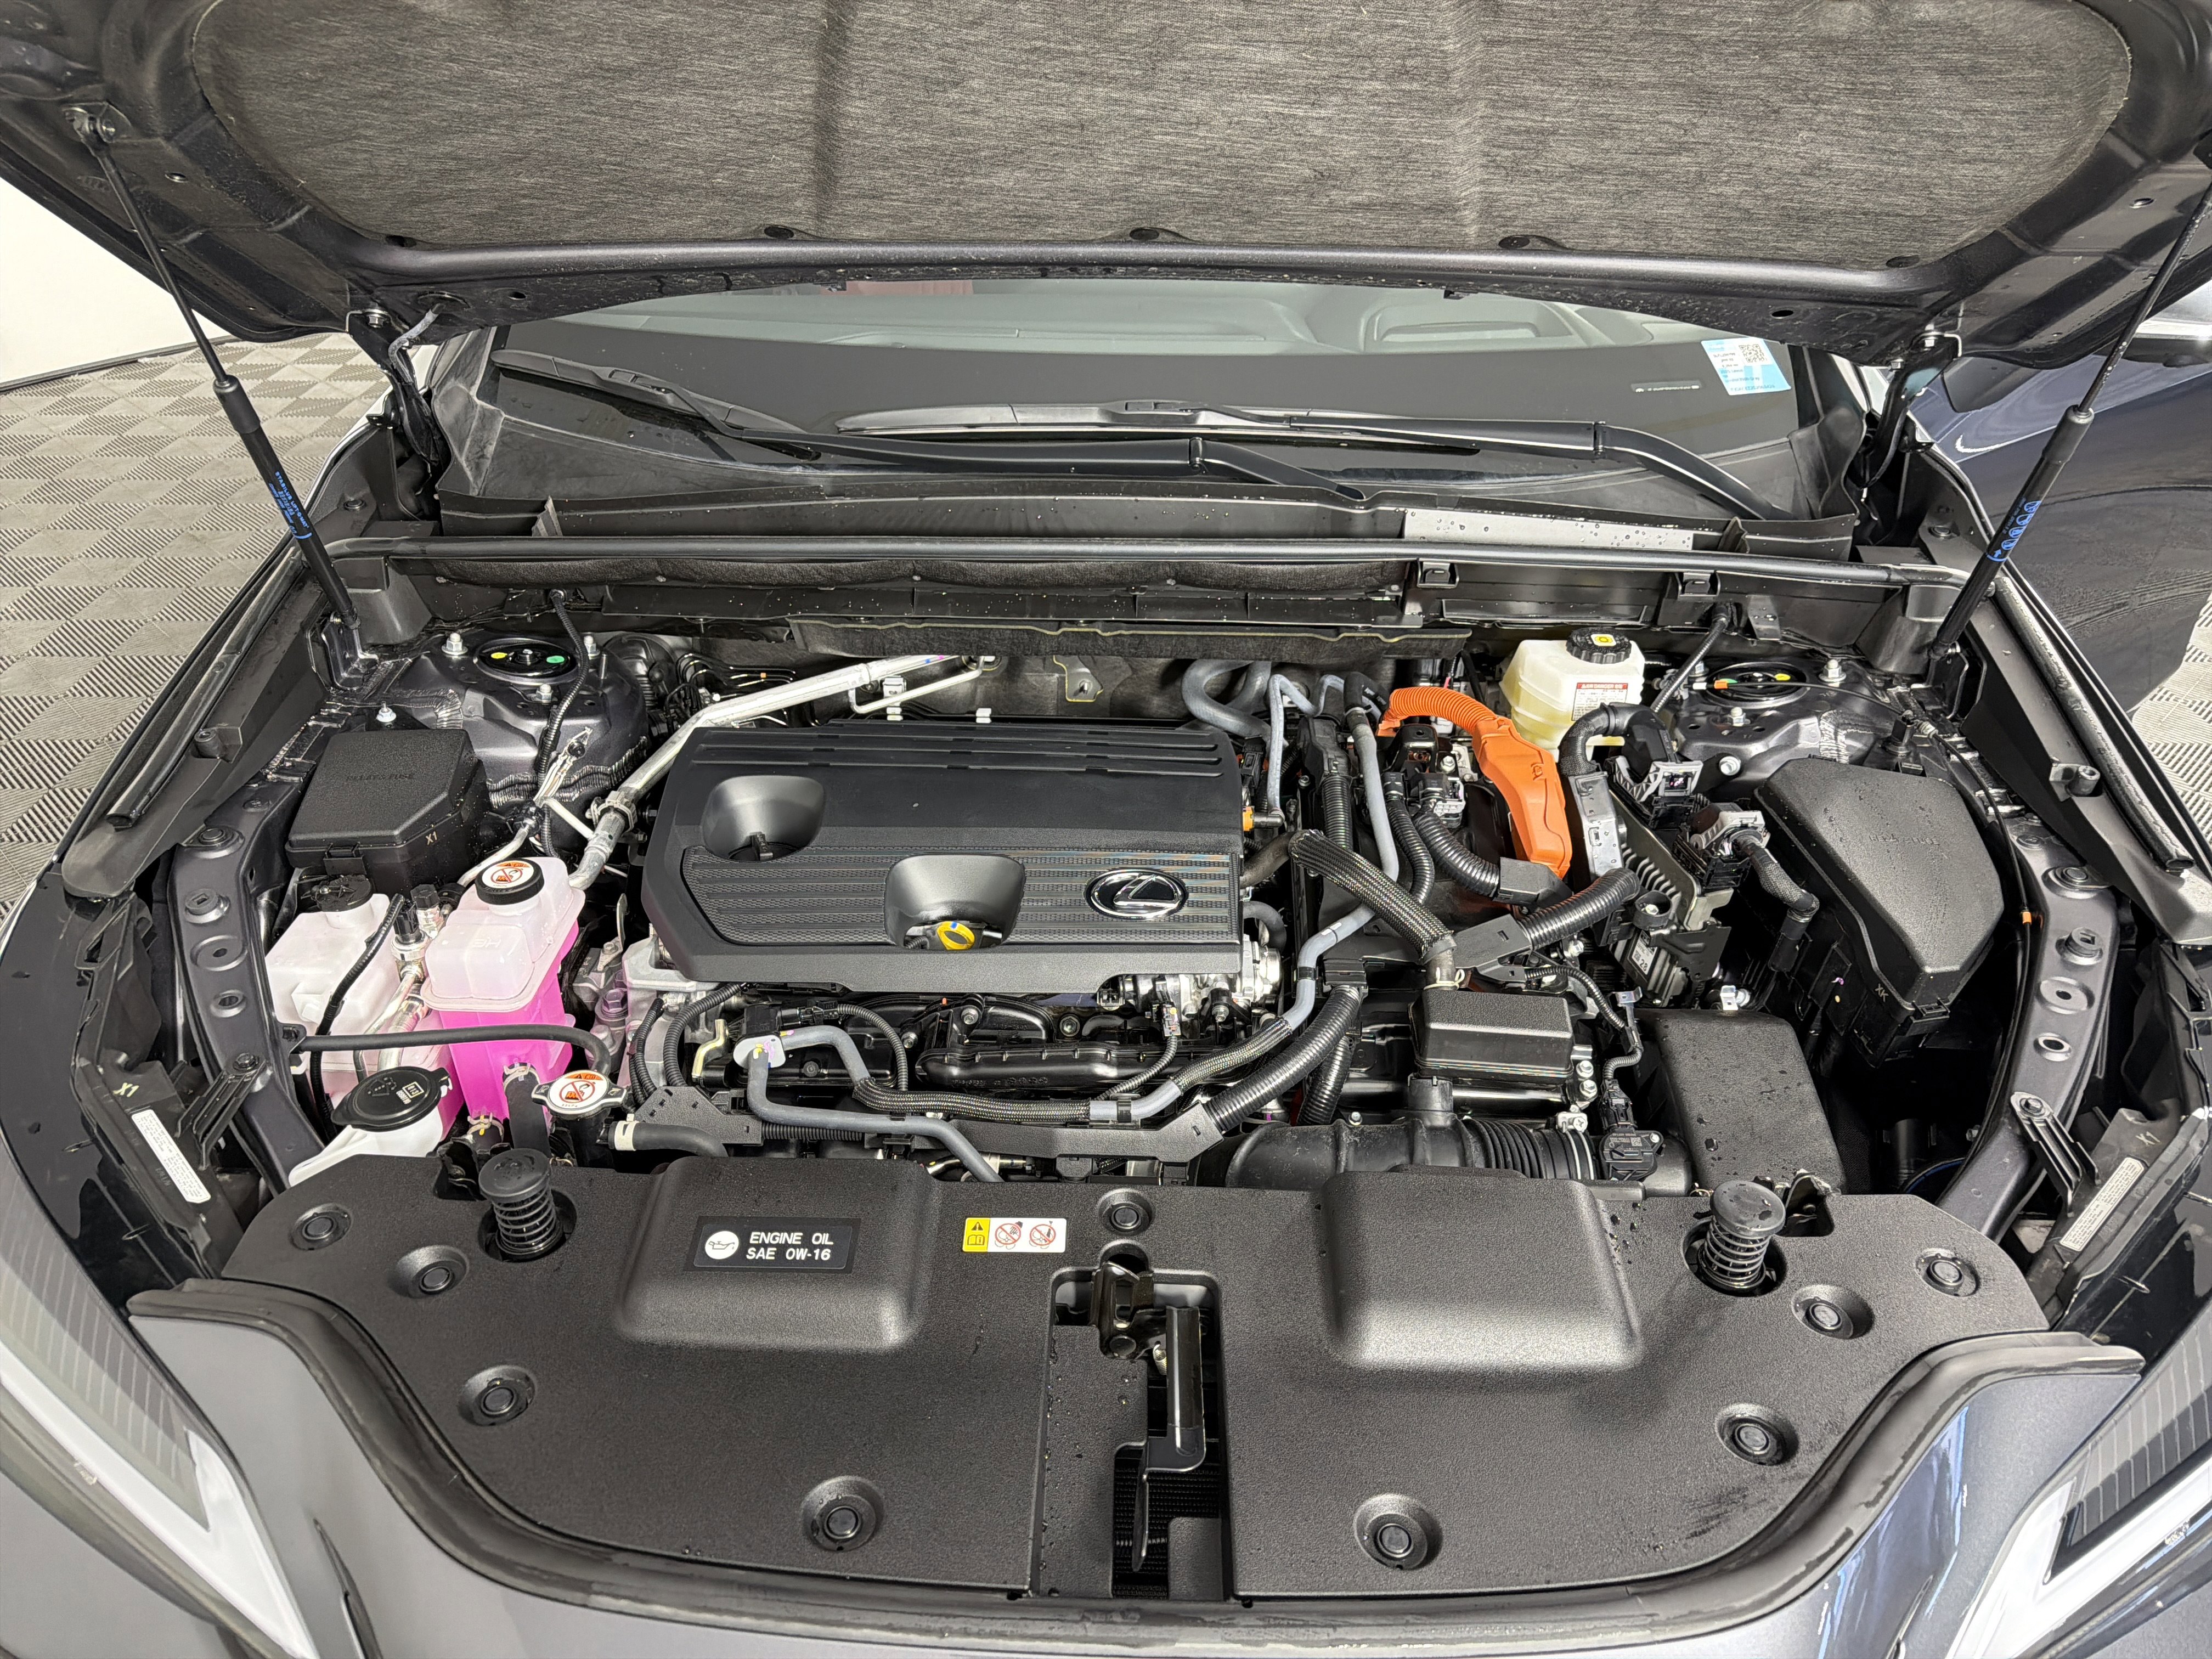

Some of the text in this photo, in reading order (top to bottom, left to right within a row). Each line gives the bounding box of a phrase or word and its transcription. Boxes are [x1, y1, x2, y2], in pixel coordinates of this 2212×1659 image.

[425, 831, 437, 845] X1
[1639, 958, 1647, 972] 28
[113, 1082, 139, 1097] X1
[749, 1232, 834, 1245] ENGINE OIL
[746, 1248, 831, 1261] SAE 0W-16
